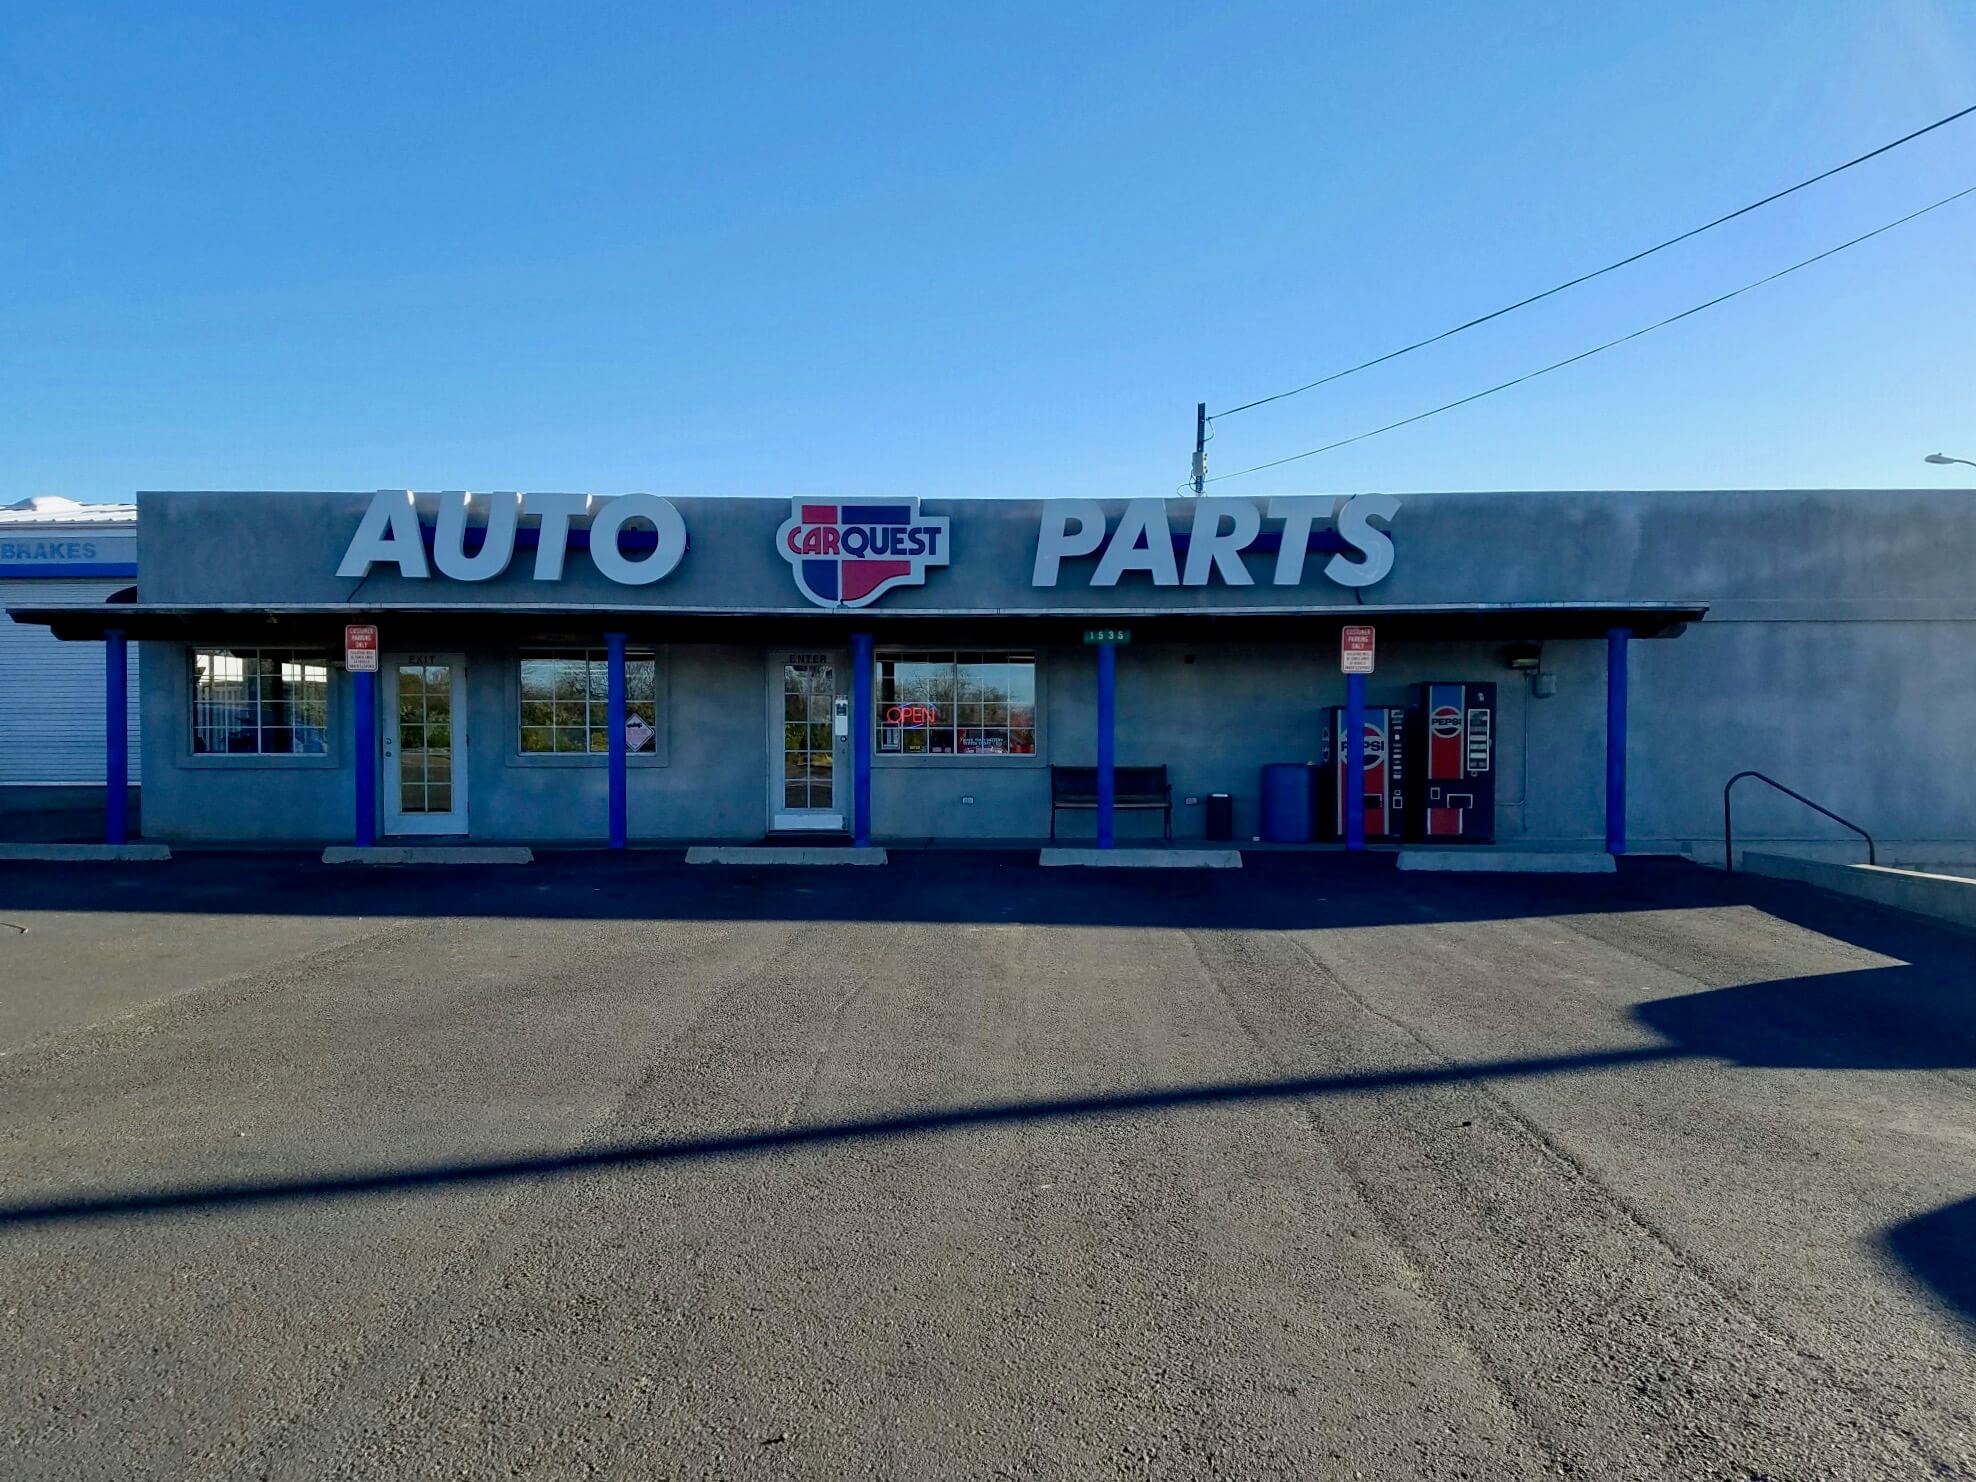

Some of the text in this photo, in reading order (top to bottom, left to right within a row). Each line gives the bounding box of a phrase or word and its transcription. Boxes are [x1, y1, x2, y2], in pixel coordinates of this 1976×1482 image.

[335, 489, 687, 585] AUTO
[787, 526, 942, 559] CARQUEST
[1031, 493, 1402, 587] PARTS
[1, 542, 97, 559] BRAKES
[1090, 630, 1124, 640] 1535
[408, 655, 435, 665] EXIT
[789, 655, 827, 664] ENTER
[886, 707, 935, 723] OPEN
[1431, 718, 1461, 726] PEPSI
[1340, 740, 1385, 752] PPSI
